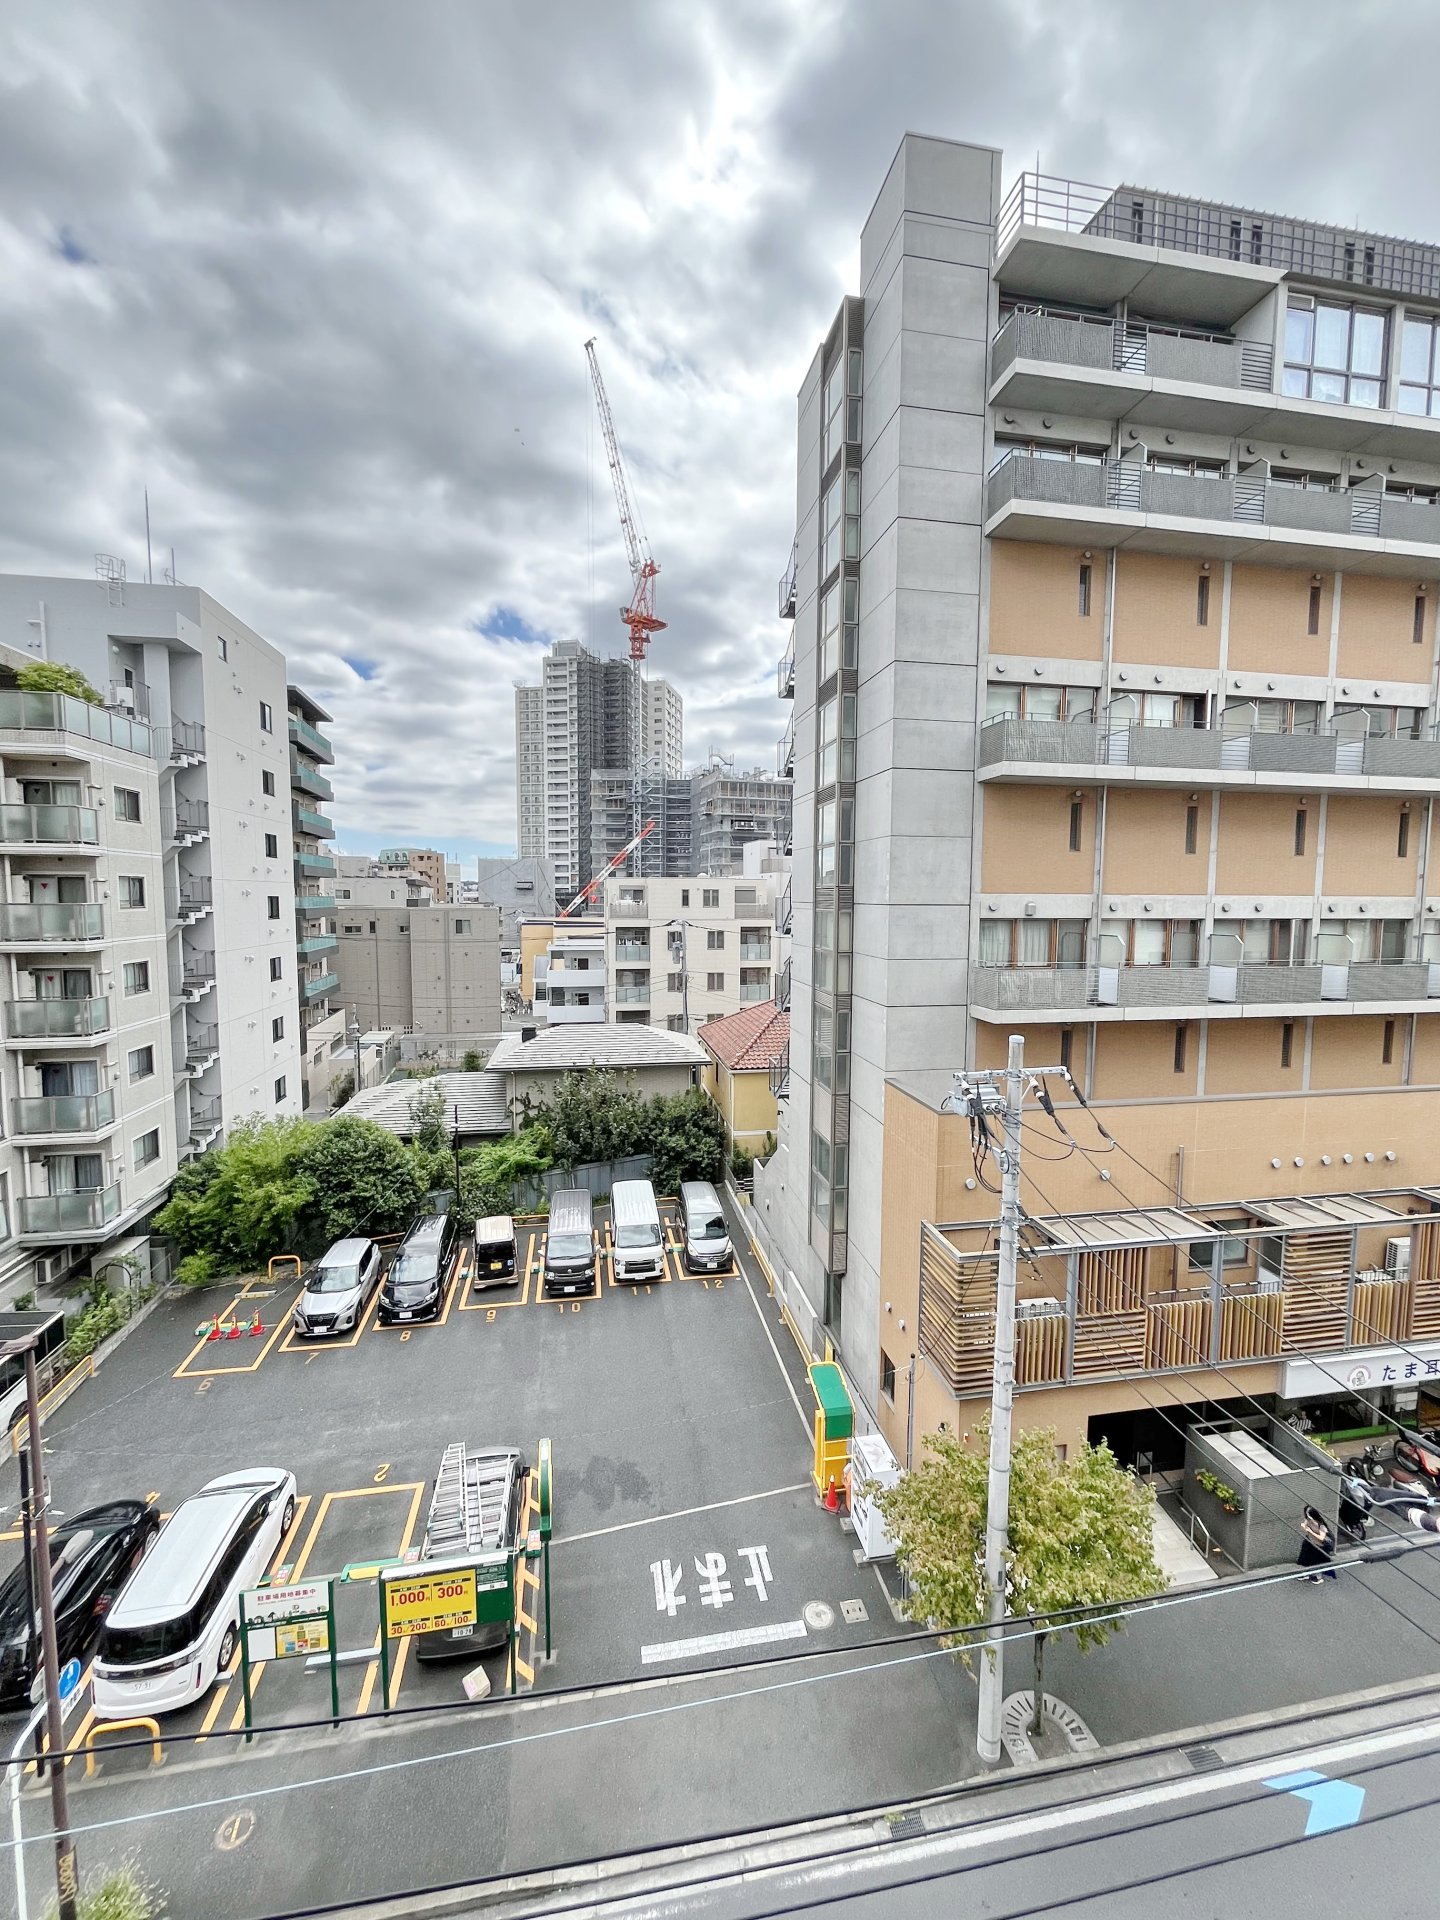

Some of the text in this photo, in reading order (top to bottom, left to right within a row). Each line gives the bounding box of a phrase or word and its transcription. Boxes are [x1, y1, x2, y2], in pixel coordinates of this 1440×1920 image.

[702, 1279, 725, 1289] 12
[631, 1285, 652, 1296] 11
[558, 1302, 581, 1313] 10
[486, 1309, 496, 1321] 9
[400, 1330, 412, 1342] 8
[304, 1352, 320, 1364] 7
[373, 1463, 391, 1482] 2
[650, 1545, 773, 1616] 止まれ
